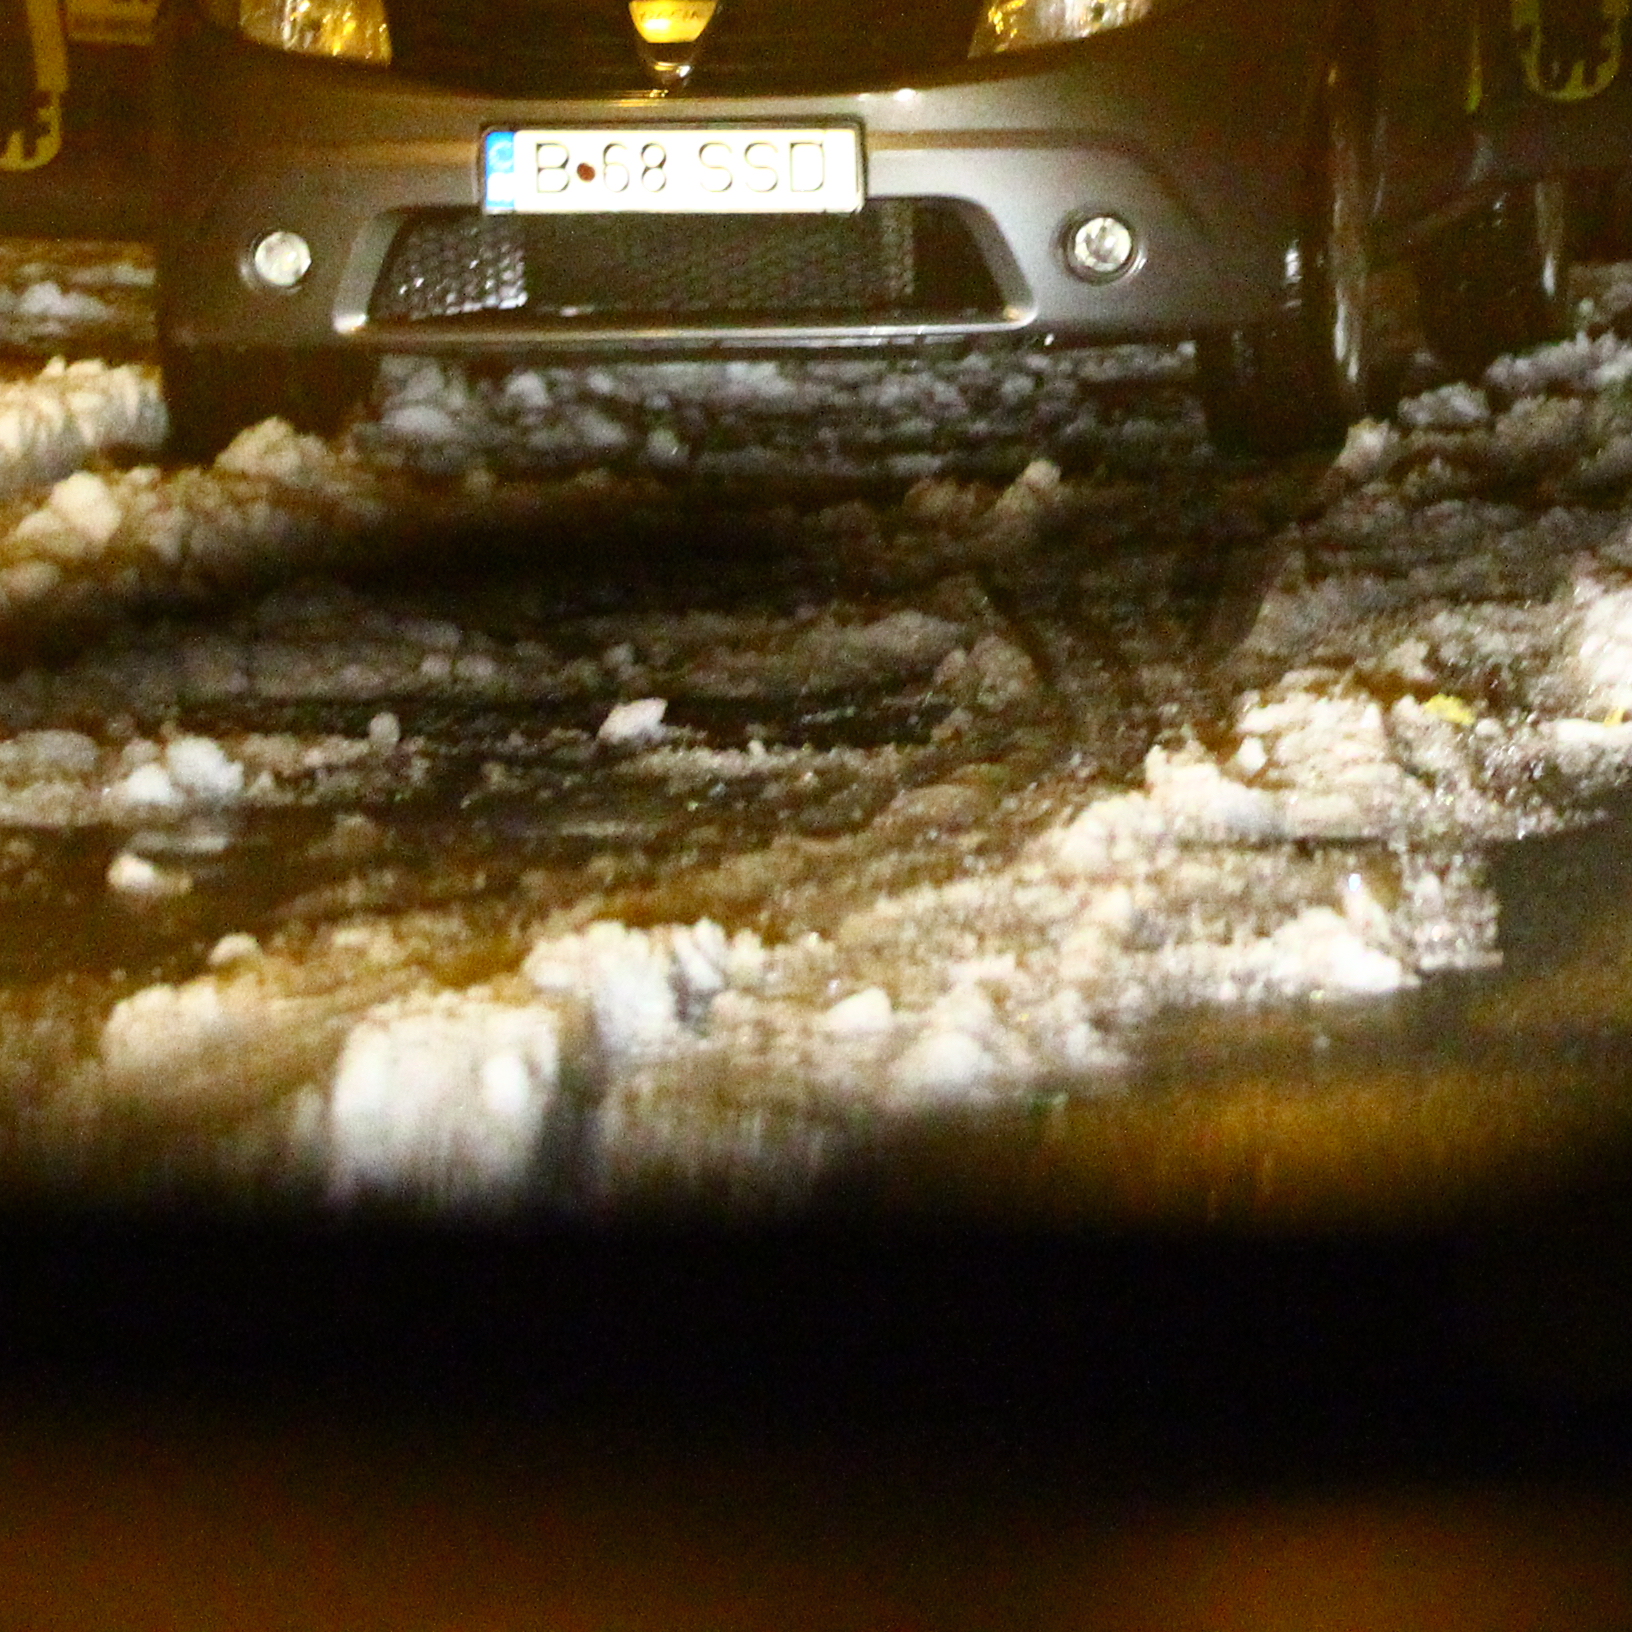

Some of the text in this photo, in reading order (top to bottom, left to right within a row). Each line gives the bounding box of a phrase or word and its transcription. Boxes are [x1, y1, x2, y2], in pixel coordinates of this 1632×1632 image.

[535, 141, 570, 194] B
[602, 141, 667, 194] 68
[698, 141, 826, 194] SSD
